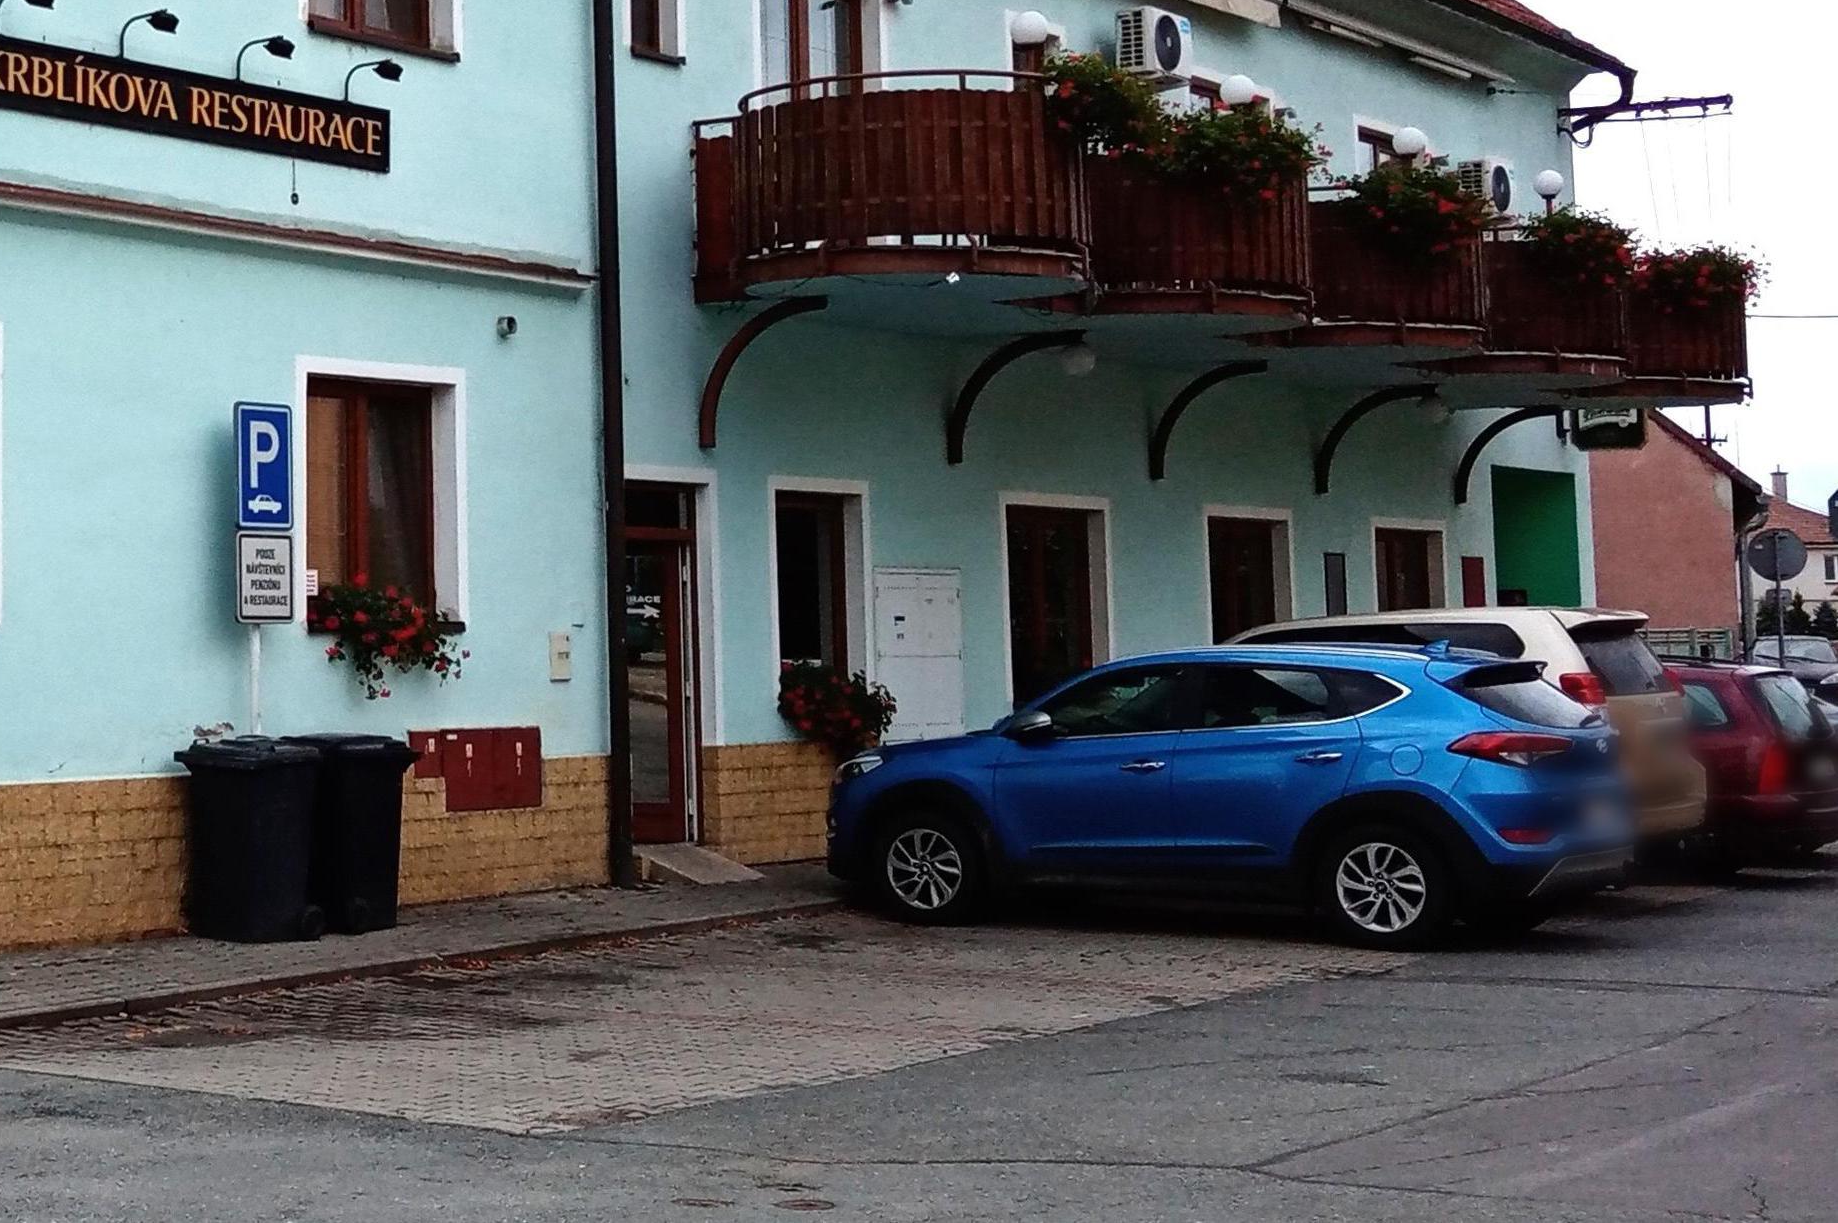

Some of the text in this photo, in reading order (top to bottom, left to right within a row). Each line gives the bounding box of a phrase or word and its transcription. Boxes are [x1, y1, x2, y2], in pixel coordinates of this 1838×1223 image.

[188, 86, 383, 157] RESTAURACE
[249, 420, 280, 489] P
[256, 548, 275, 559] POUZE
[249, 594, 288, 607] RESTAURACE
